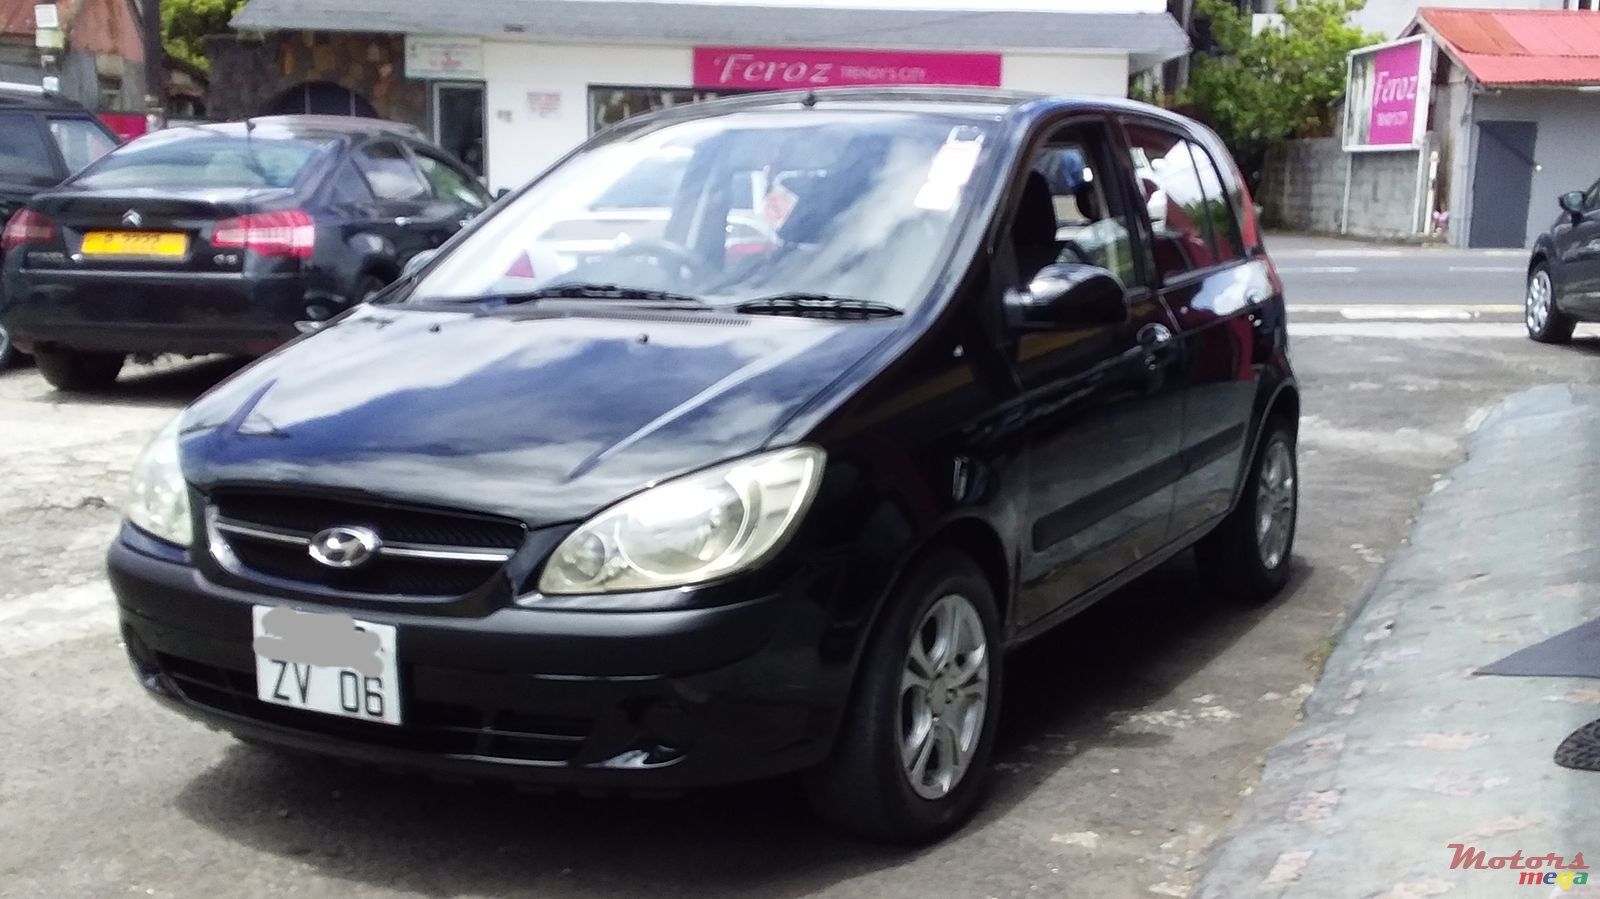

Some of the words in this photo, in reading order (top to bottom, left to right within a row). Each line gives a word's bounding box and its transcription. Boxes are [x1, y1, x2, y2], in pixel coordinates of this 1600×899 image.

[717, 53, 833, 84] Feroz
[1374, 71, 1418, 107] Feroz
[268, 659, 311, 703] ZV
[340, 670, 384, 717] 06
